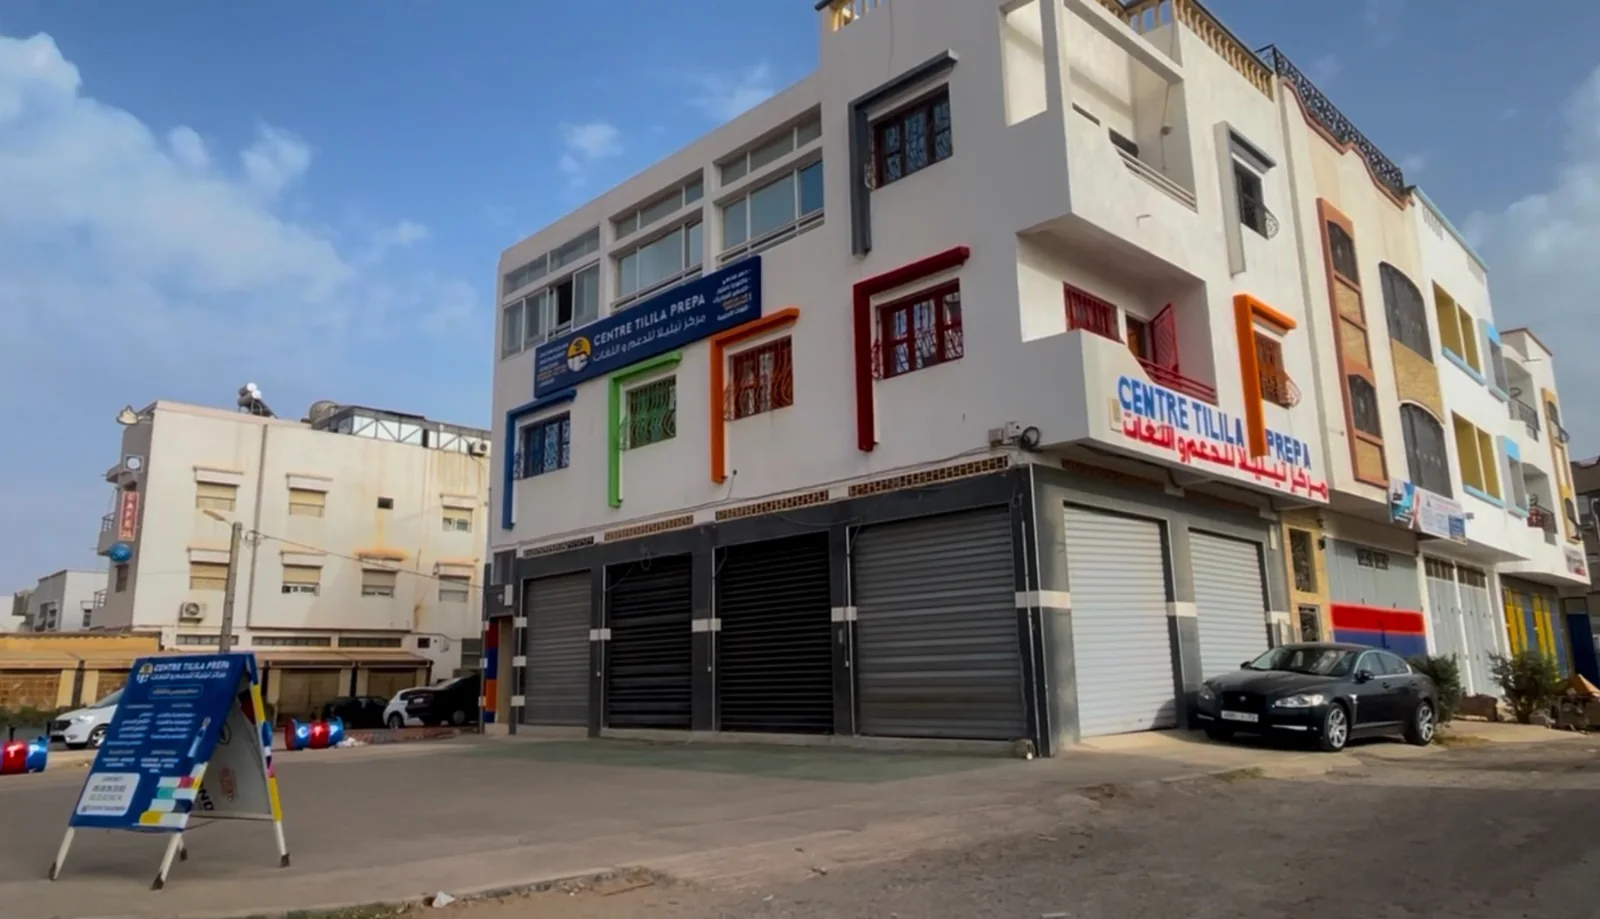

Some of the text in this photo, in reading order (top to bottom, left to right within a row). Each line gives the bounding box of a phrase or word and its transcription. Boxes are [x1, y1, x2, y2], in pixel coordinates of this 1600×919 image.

[593, 322, 633, 346] CENTRE
[634, 309, 667, 330] TILILA
[670, 293, 706, 317] PREPA
[683, 314, 707, 331] مركز
[592, 345, 620, 362] اللغات
[627, 330, 656, 352] للدعم
[1118, 375, 1311, 470] CENTRE TILILA PREPA
[1122, 411, 1176, 451] اللغات
[1288, 465, 1328, 500] مركز
[153, 660, 230, 673] CENTRE TILILA PREPA
